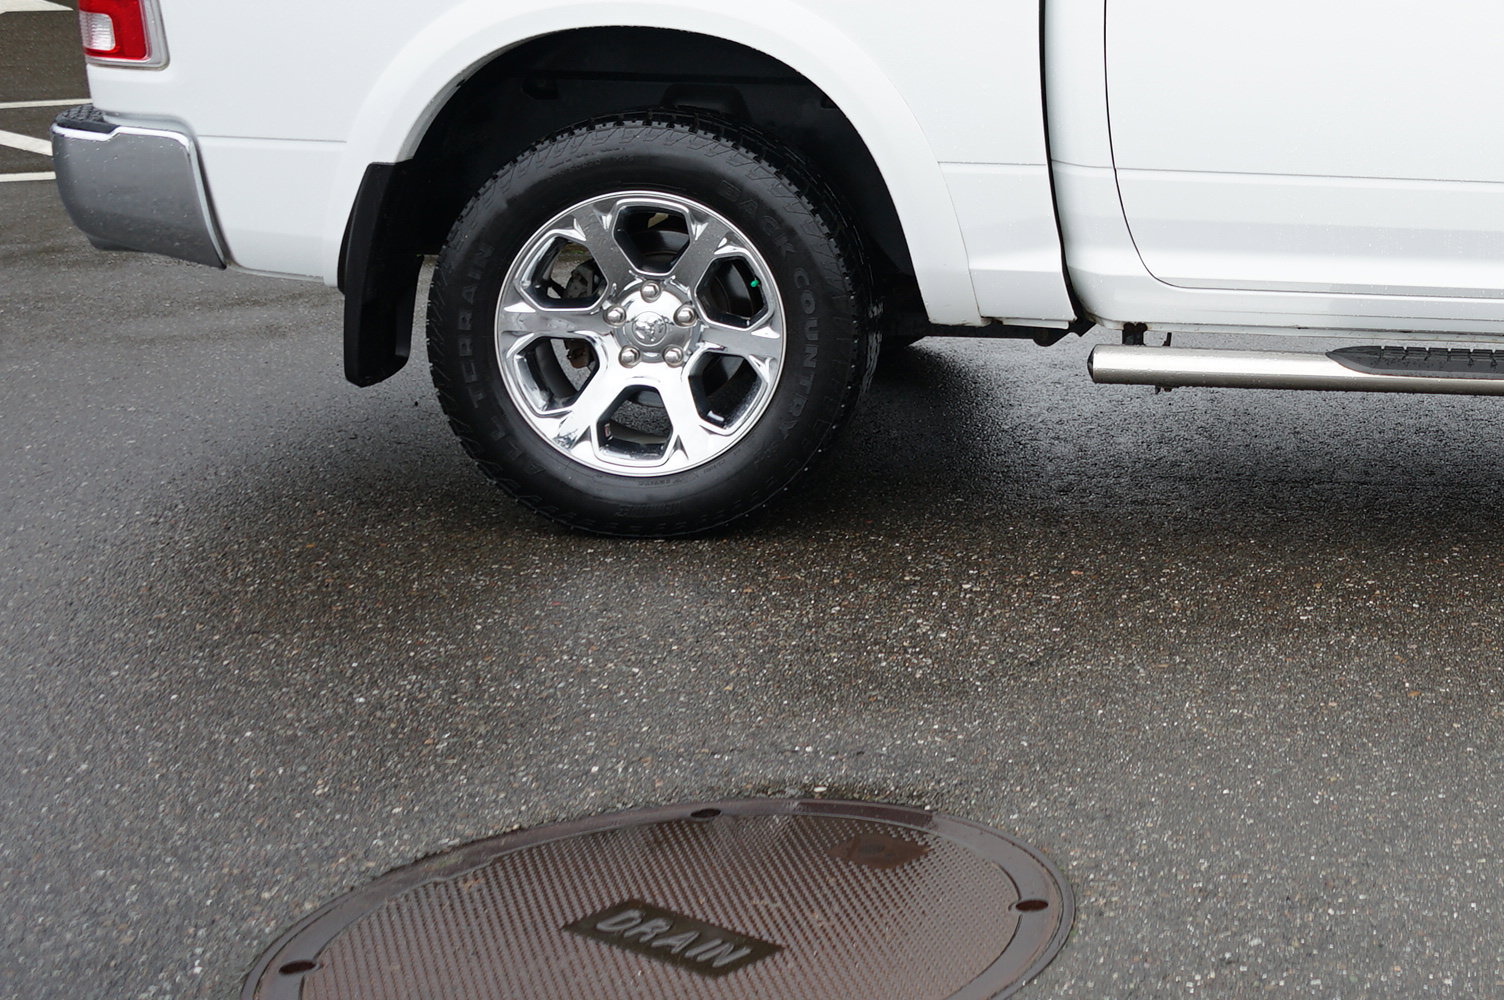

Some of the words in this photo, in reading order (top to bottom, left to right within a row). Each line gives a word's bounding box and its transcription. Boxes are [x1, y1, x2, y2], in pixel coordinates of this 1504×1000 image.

[457, 243, 496, 409] TERRAIN
[780, 267, 820, 440] COUNTRY
[596, 908, 752, 969] DRAIN
